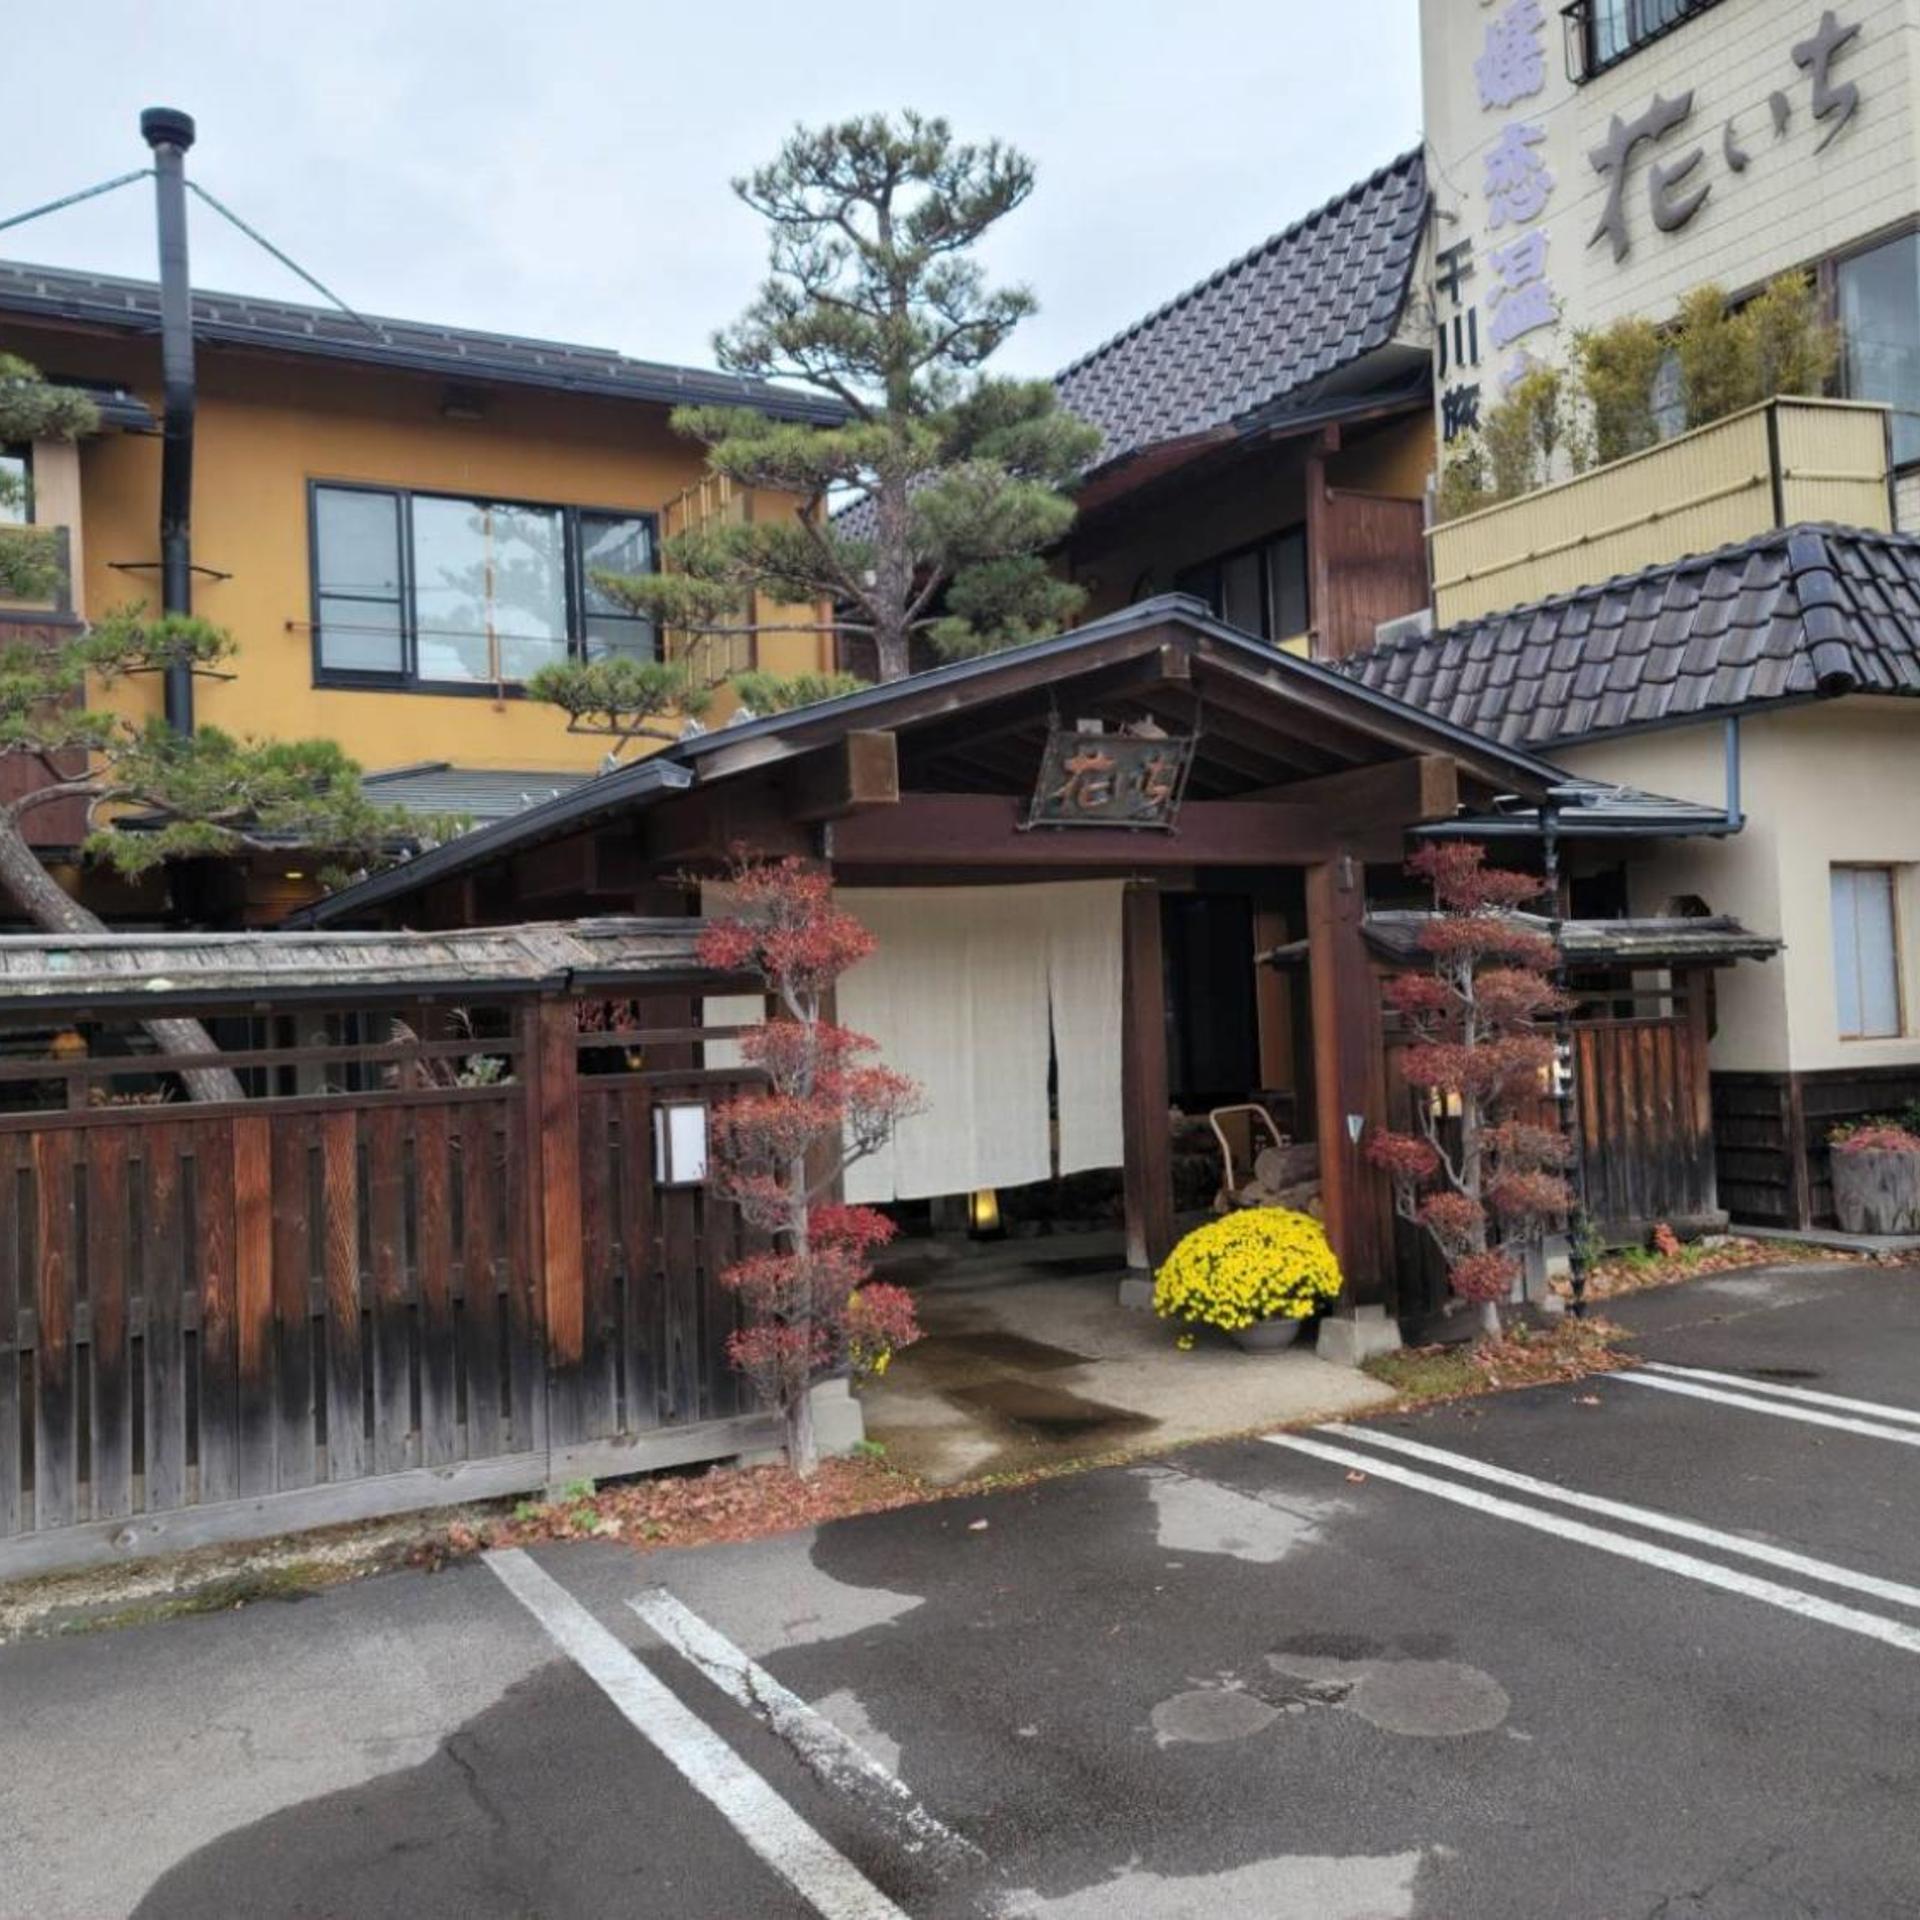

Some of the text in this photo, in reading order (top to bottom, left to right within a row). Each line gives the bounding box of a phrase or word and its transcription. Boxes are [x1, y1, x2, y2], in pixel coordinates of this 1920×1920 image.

[1586, 9, 1864, 265] 花いち
[1435, 237, 1484, 490] 干川旅
